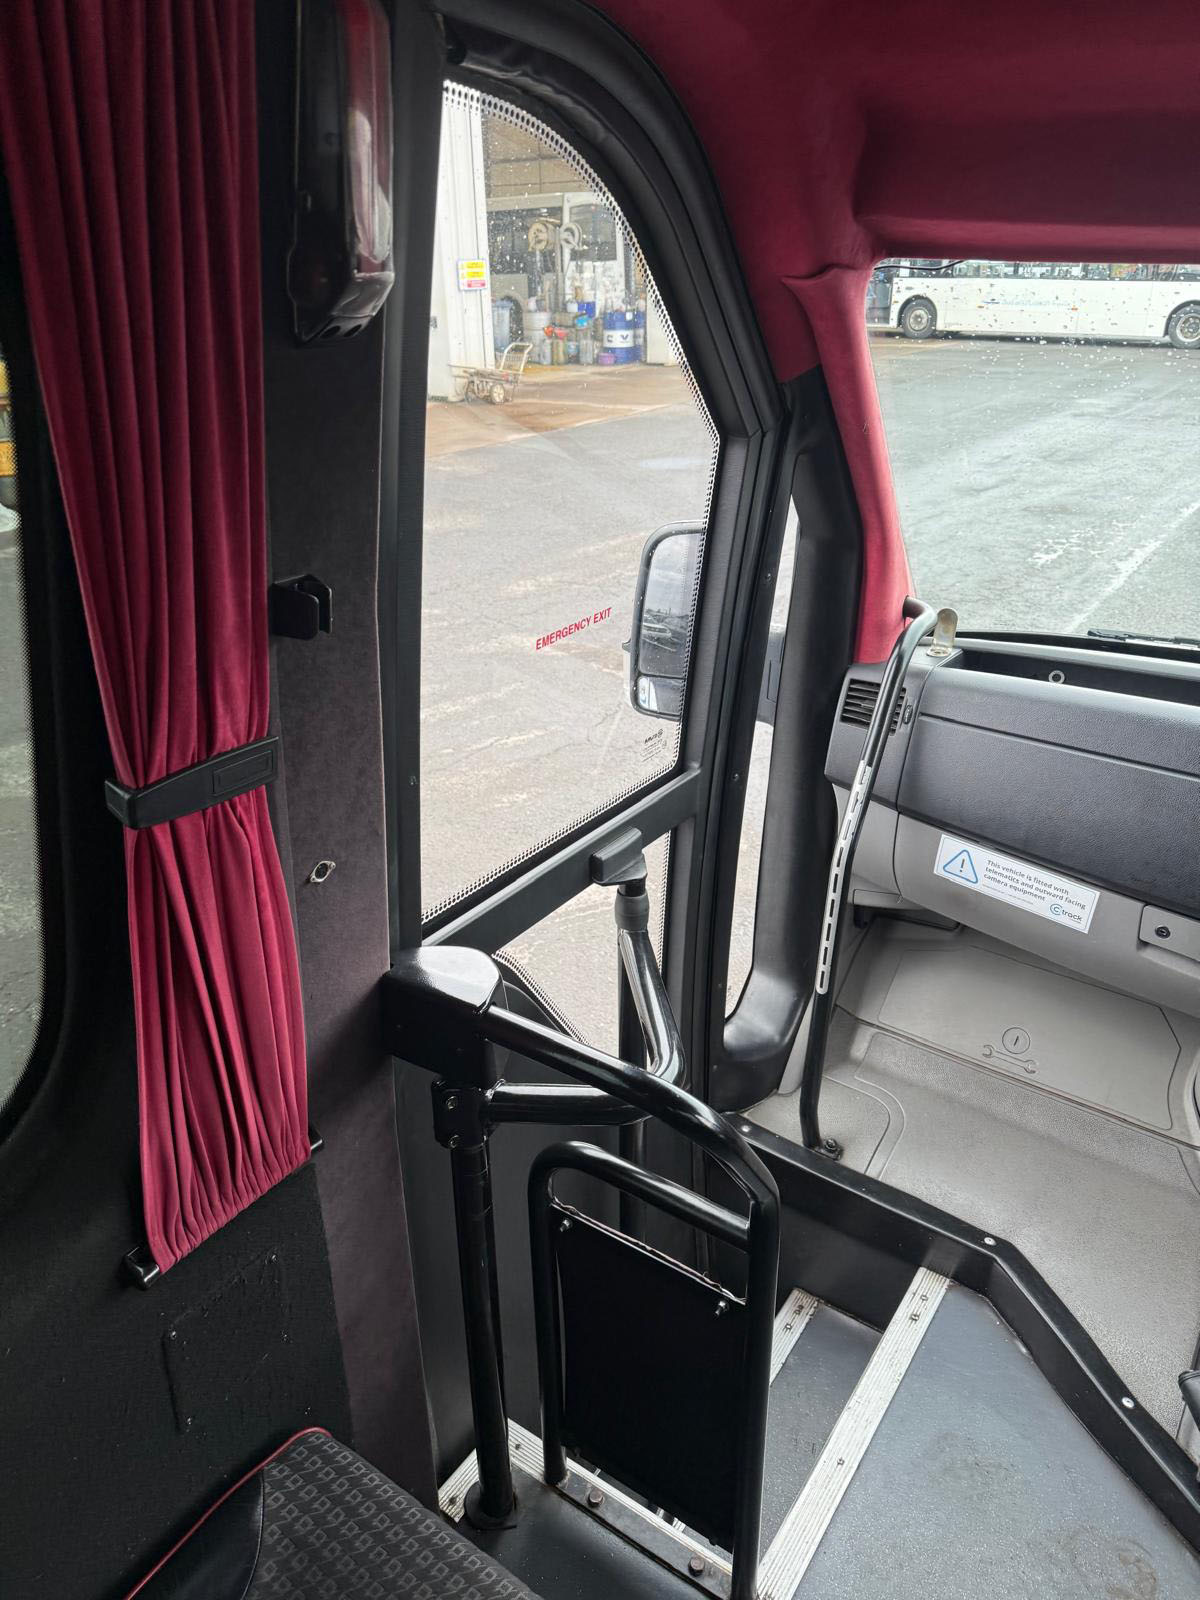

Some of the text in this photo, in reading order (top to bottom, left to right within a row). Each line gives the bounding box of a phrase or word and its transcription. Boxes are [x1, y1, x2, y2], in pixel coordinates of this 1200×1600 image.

[536, 607, 612, 650] EMERGENCY EXIT
[983, 873, 1008, 887] camera
[1009, 884, 1046, 902] equipment
[985, 867, 1019, 884] telematics
[1020, 881, 1034, 890] and
[1034, 886, 1064, 901] outward
[1064, 896, 1086, 910] facing
[987, 860, 1001, 869] This
[1002, 864, 1025, 878] vehicle
[1033, 877, 1053, 889] fitted
[1053, 886, 1069, 896] with
